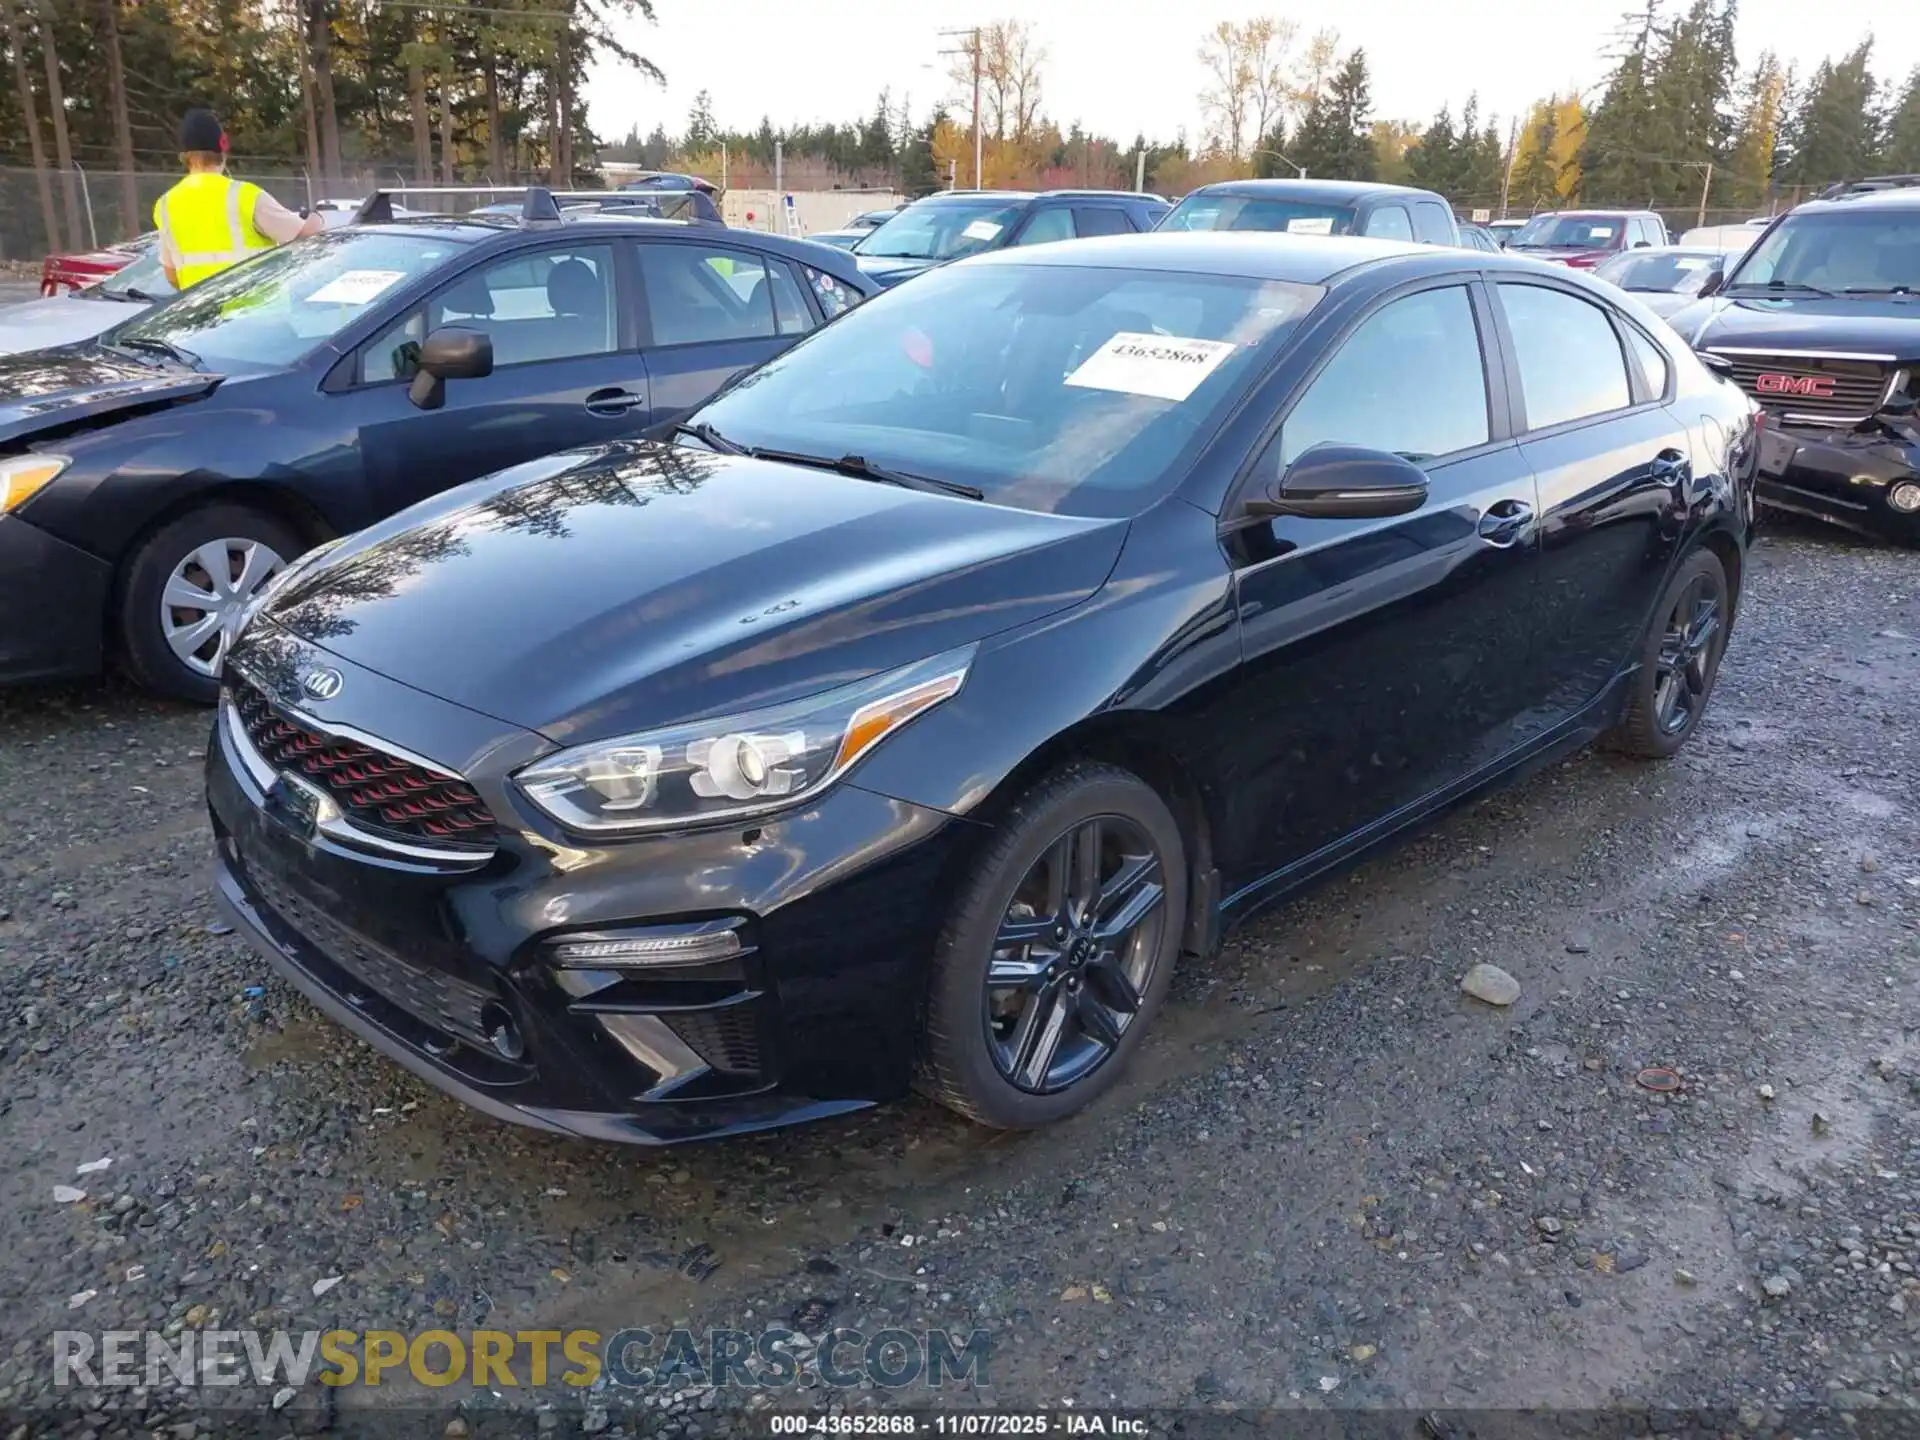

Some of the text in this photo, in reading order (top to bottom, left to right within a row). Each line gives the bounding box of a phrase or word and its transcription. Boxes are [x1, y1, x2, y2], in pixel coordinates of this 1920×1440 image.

[1112, 344, 1209, 364] 43652868
[1756, 373, 1836, 396] GMC
[304, 671, 338, 697] KIA
